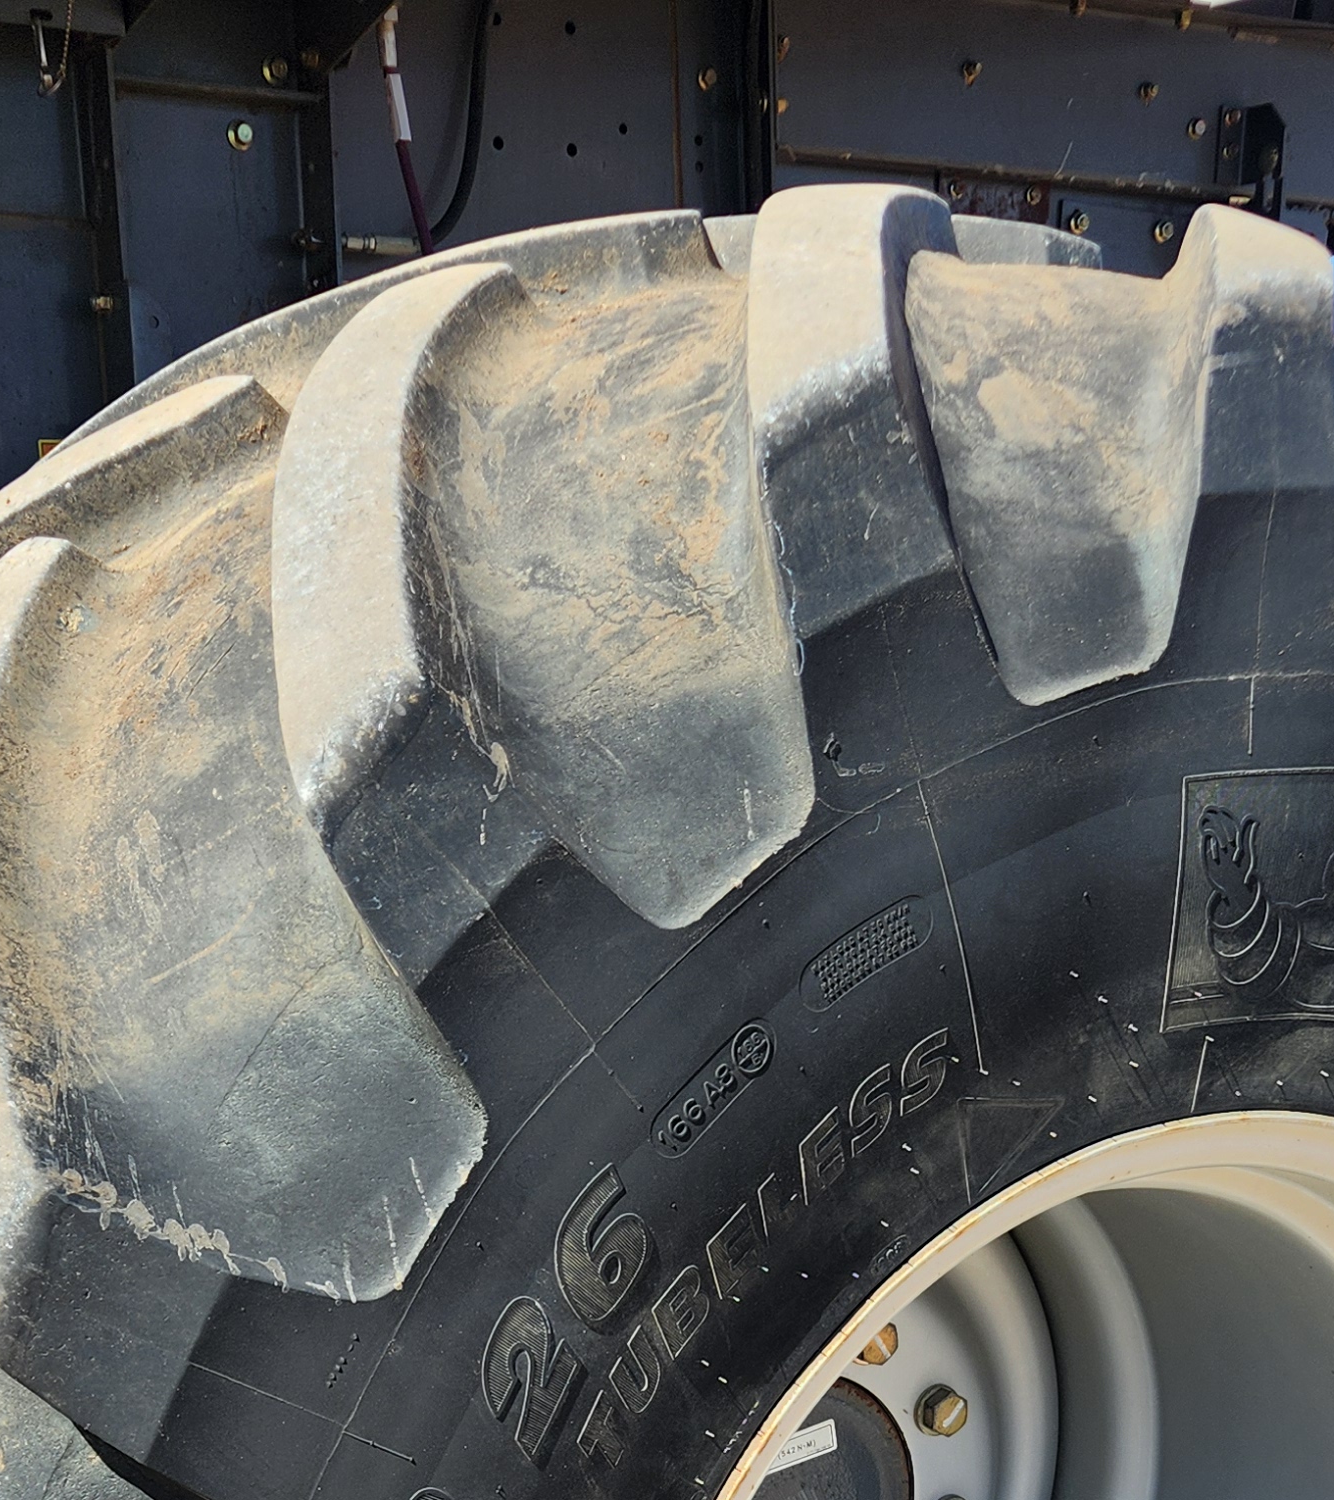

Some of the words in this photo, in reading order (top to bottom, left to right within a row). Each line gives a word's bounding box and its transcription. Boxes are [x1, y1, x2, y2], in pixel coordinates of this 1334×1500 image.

[576, 1027, 955, 1470] TUBELESS
[658, 1097, 703, 1149] 166
[703, 1063, 734, 1106] A8
[481, 1163, 655, 1464] 26
